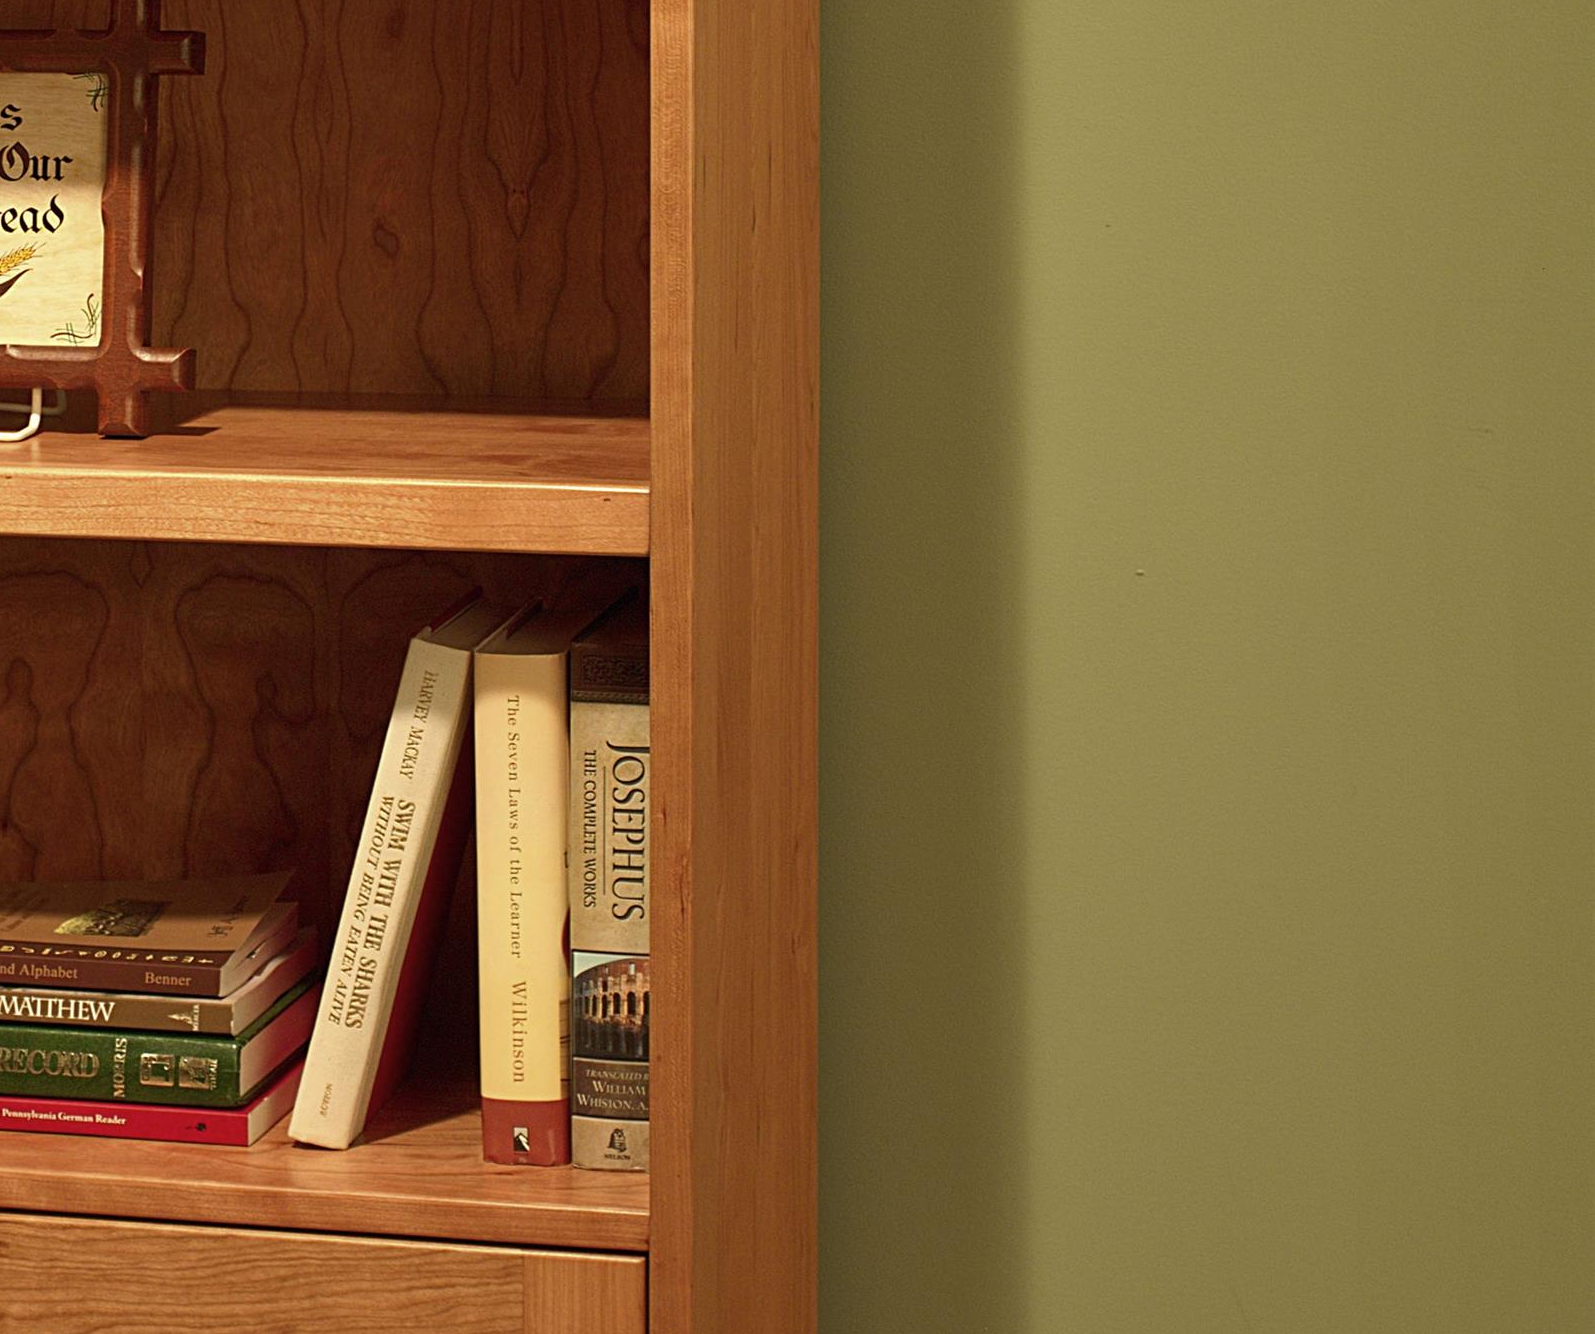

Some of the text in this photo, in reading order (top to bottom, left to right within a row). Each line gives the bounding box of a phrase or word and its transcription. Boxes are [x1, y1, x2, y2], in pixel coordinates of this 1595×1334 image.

[400, 670, 438, 779] HARVEY MACKAY
[508, 695, 522, 959] The Seven Laws of the Learner
[584, 750, 596, 909] THE COMPLETE WORKS
[606, 740, 650, 921] JOSEPHUS
[328, 797, 394, 1025] WITHOUT BEING EATEN ALIVE
[345, 799, 416, 1029] SWIM WITH THE SHARKS
[20, 964, 78, 981] Alphabet
[144, 972, 192, 987] Benner
[113, 1037, 128, 1098] MORRIS
[512, 981, 528, 1083] Wilkinson
[2, 1108, 56, 1121] Pennsylvania
[58, 1112, 94, 1123] German
[96, 1115, 126, 1125] Reader
[592, 1080, 646, 1095] WILLIAM
